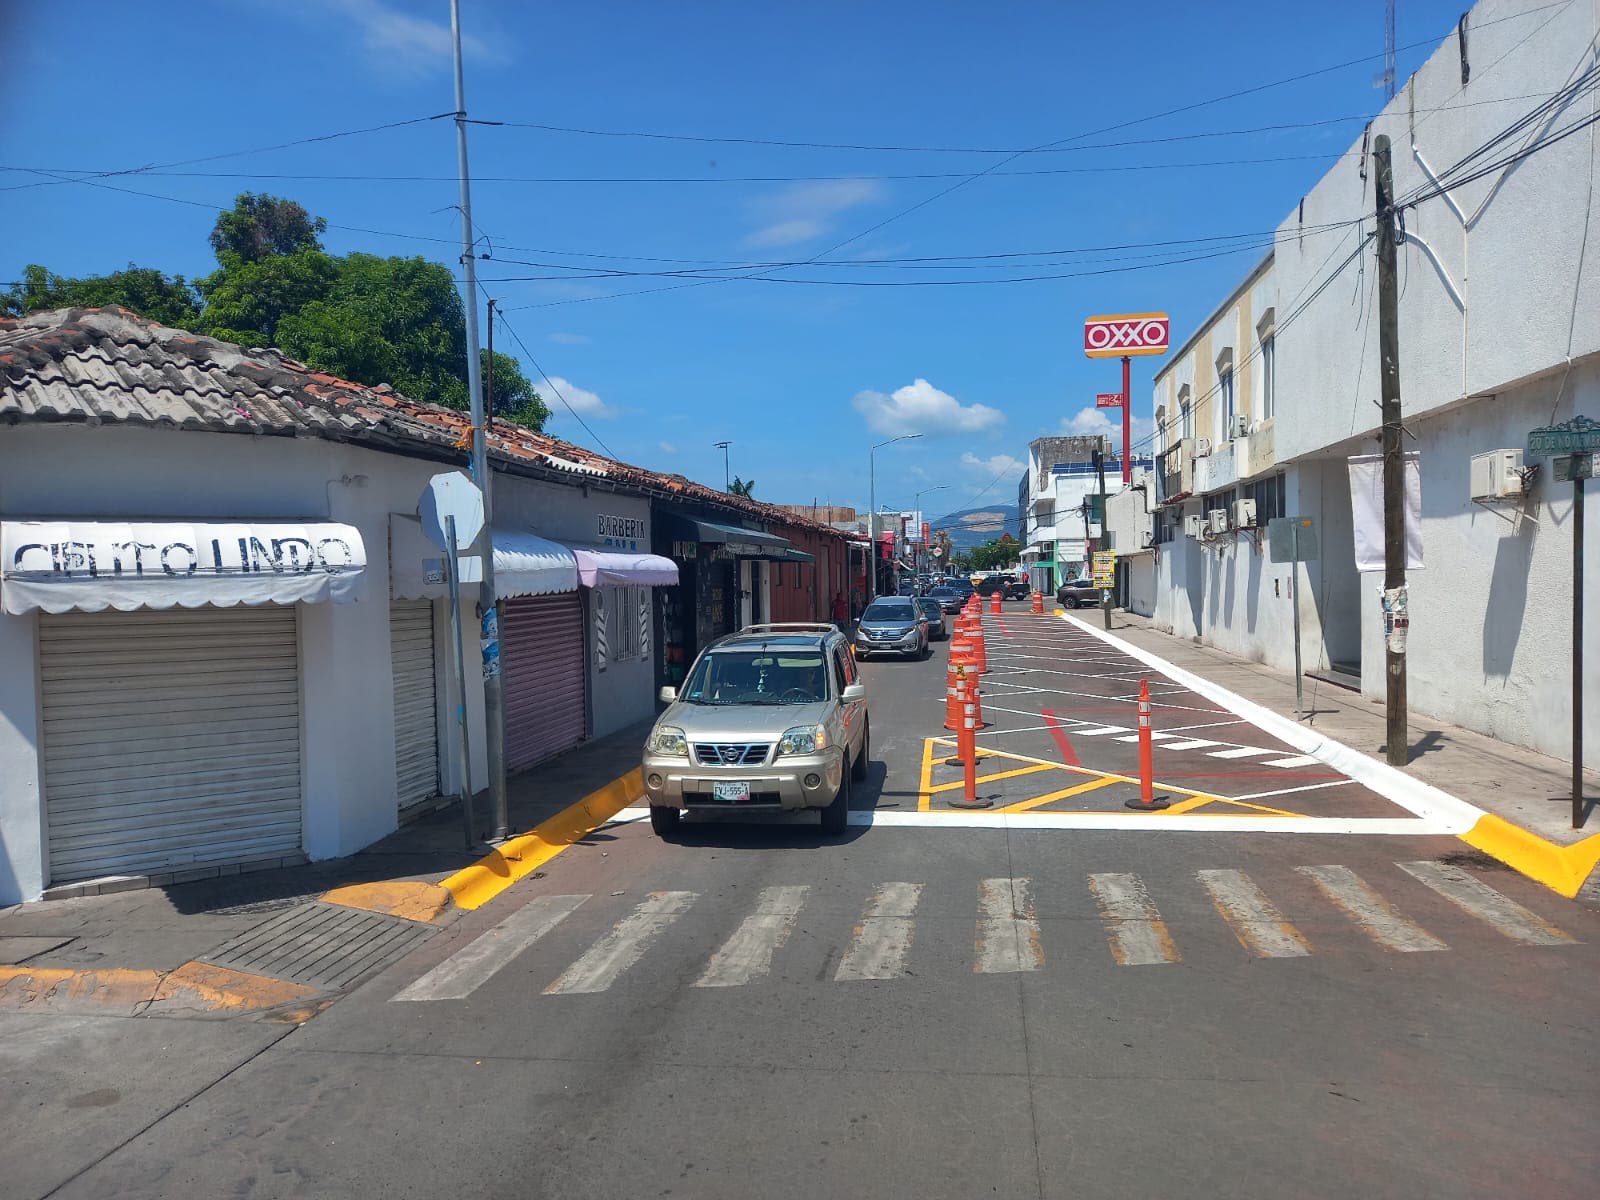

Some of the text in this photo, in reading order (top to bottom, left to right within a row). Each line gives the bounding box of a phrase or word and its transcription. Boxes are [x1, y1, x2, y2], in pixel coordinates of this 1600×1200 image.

[1088, 321, 1165, 348] OXXO
[1530, 437, 1542, 450] 20
[1545, 436, 1555, 449] DE
[598, 514, 646, 539] BARBERIA
[211, 536, 352, 576] LINDO
